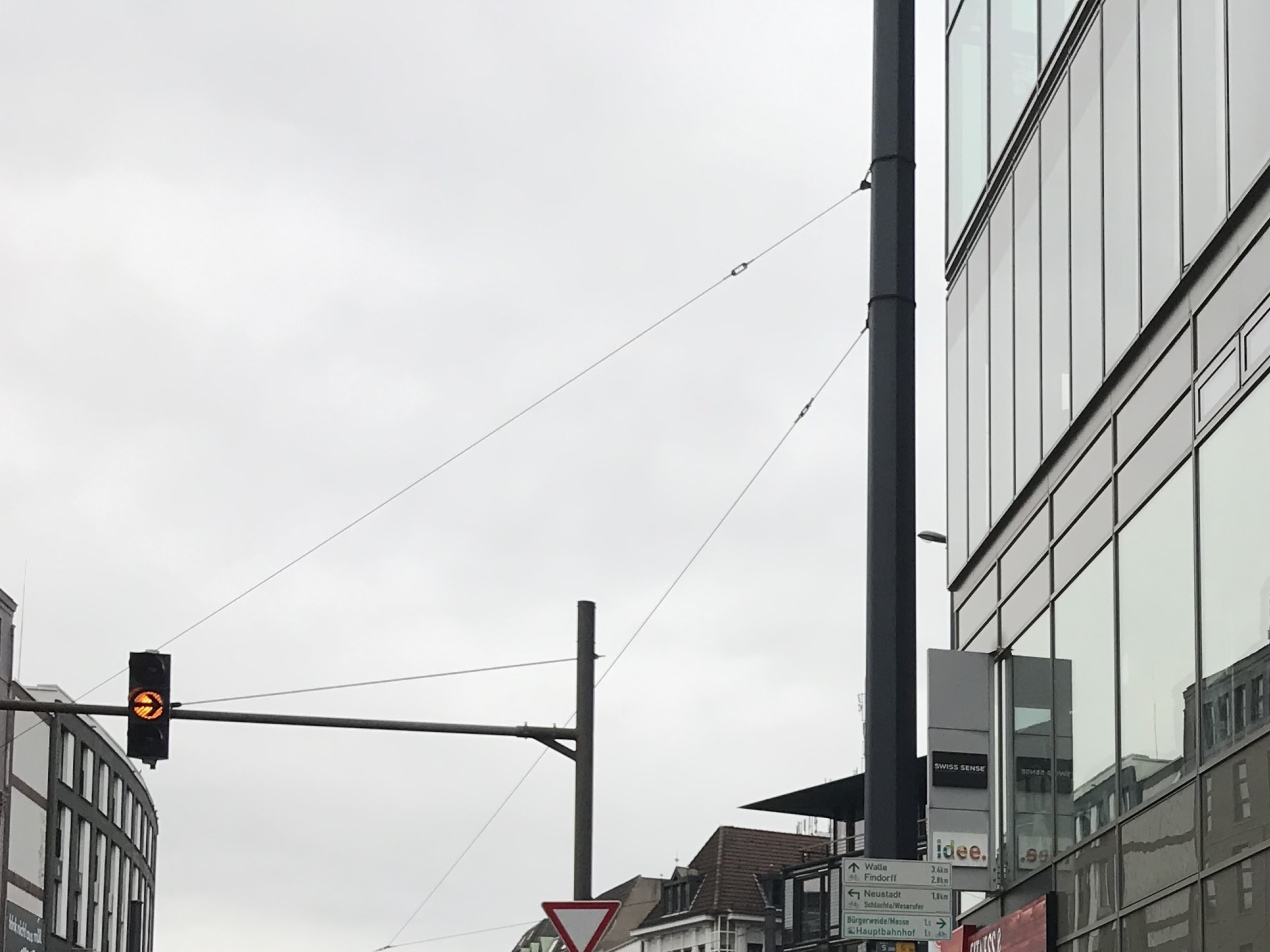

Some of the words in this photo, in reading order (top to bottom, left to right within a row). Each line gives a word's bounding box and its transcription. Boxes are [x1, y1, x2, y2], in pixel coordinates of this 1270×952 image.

[934, 762, 959, 771] SWISS
[960, 764, 985, 773] SENSE
[936, 838, 987, 862] idee.
[864, 863, 888, 871] Walle
[864, 873, 897, 882] Findorff
[864, 889, 902, 899] Neustadt
[856, 926, 916, 937] Hauptbahnhof
